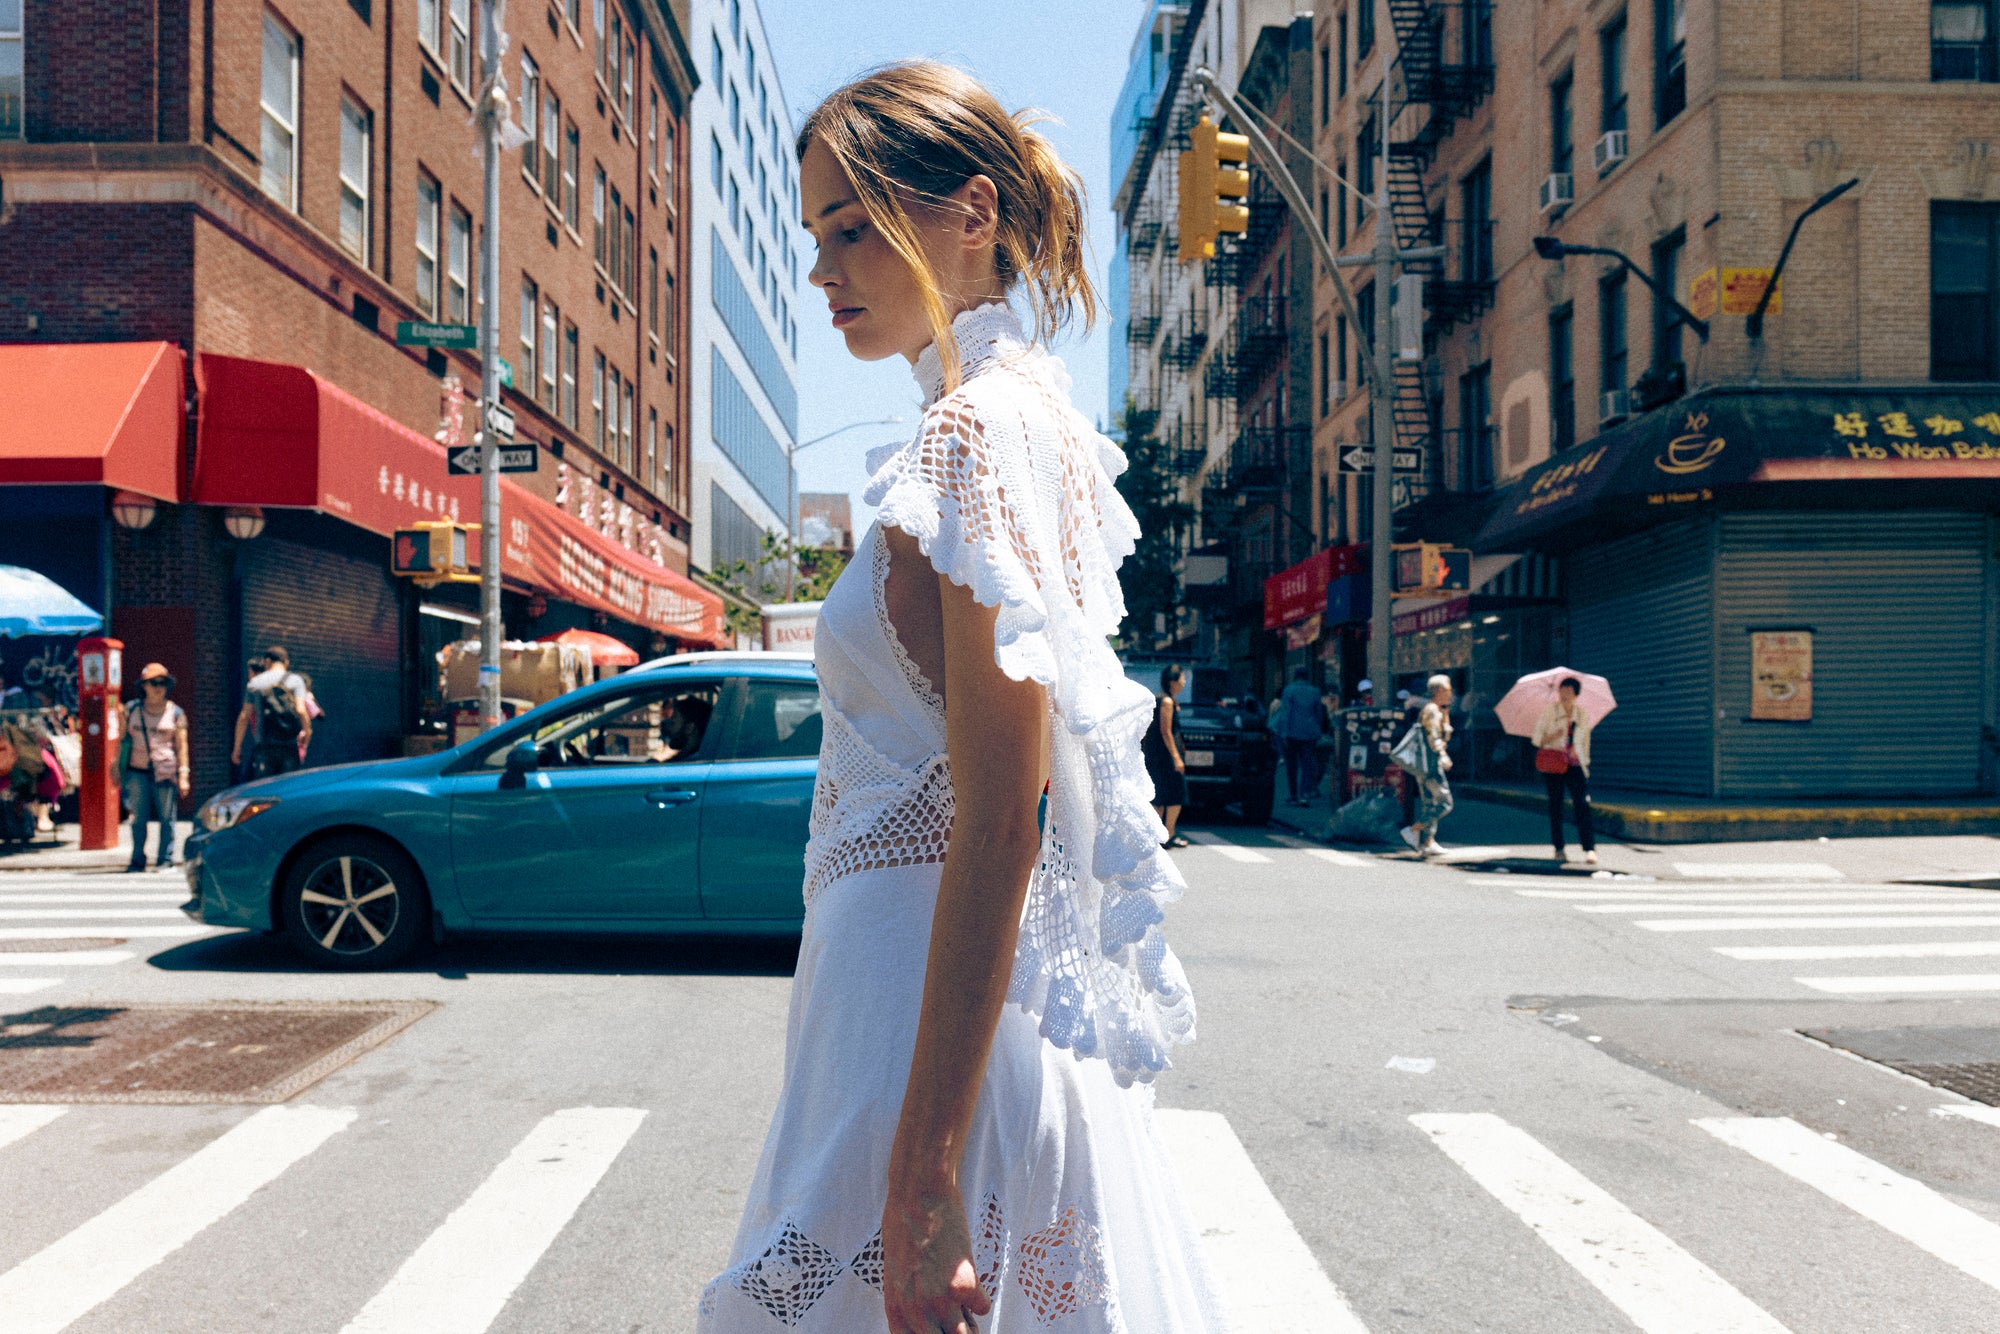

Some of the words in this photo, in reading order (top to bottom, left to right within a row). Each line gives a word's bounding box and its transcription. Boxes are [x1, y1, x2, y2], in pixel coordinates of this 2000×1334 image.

[411, 321, 465, 339] Elizabeth
[1847, 442, 1888, 459] Ho
[1891, 442, 1950, 459] Won
[560, 534, 604, 599] HONG
[609, 565, 643, 615] KONG
